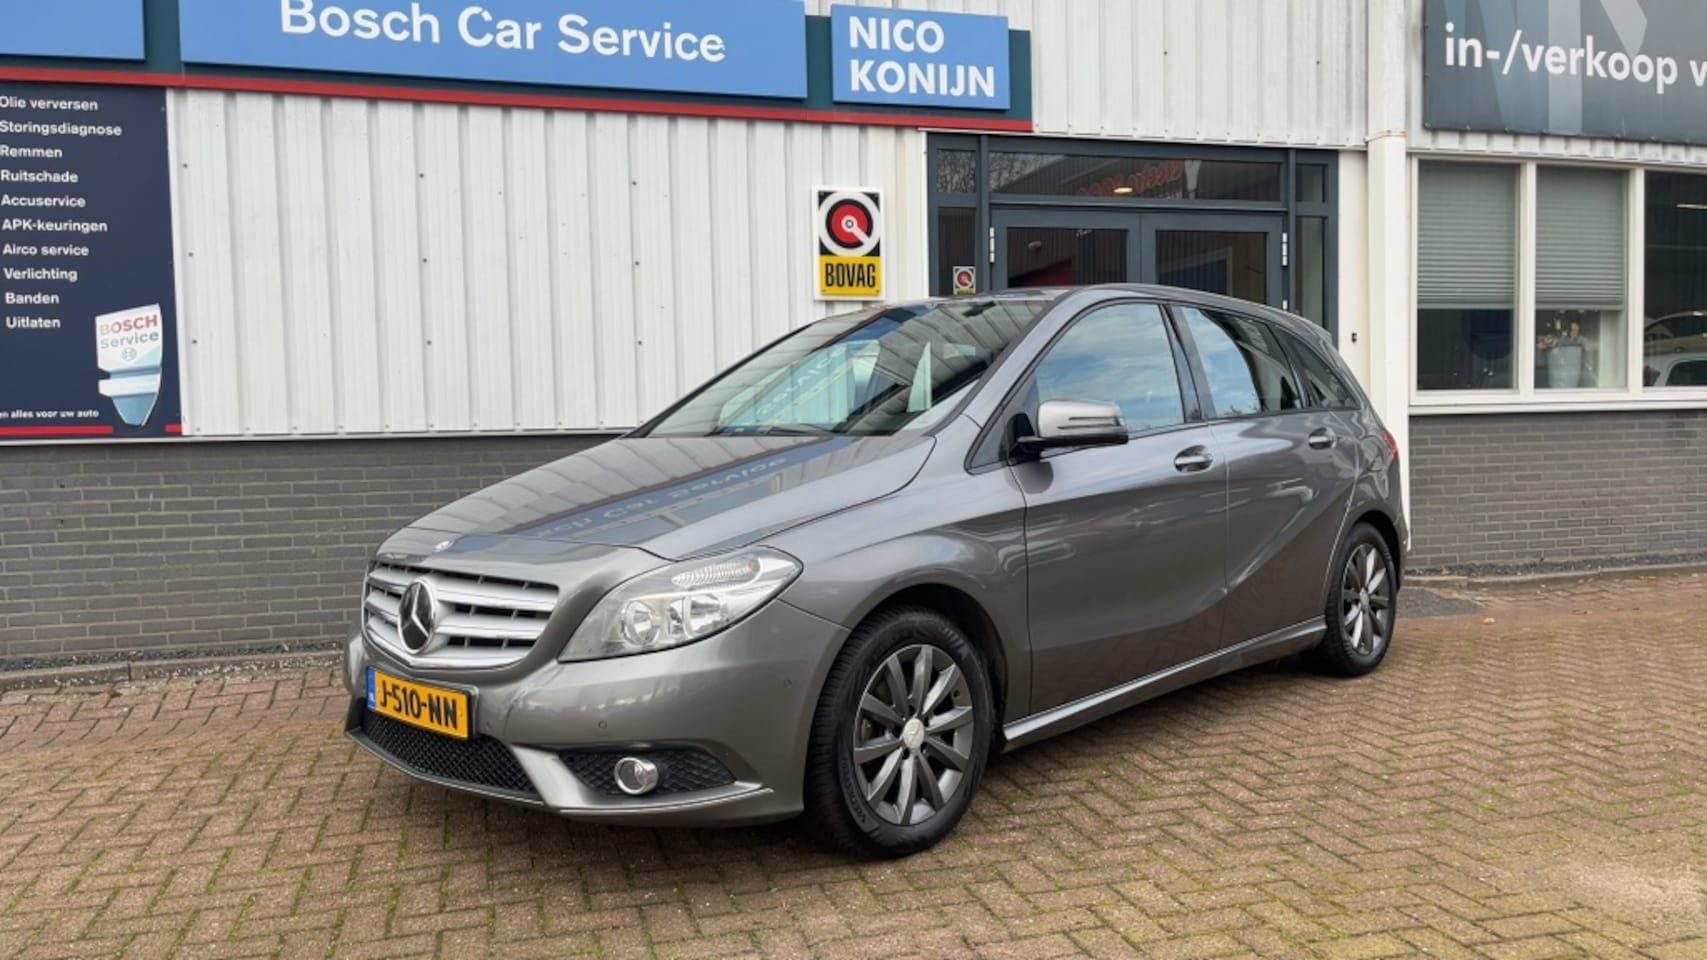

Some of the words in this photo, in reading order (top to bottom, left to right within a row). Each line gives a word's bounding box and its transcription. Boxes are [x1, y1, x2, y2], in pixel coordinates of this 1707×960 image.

[281, 0, 440, 43] Bosch
[458, 6, 542, 50] Car
[558, 14, 726, 63] Service
[850, 16, 945, 54] NICO
[1445, 22, 1678, 94] in-/verkoop
[850, 59, 995, 97] KONIJN
[0, 96, 26, 108] Olie
[30, 100, 98, 110] verversen
[0, 120, 122, 136] Storingsdiagnose
[0, 145, 63, 158] Remmen
[1, 170, 78, 183] Ruitschade
[1, 194, 86, 207] Accuservice
[2, 219, 108, 233] APK-keuringen
[3, 244, 38, 256] Airco
[41, 244, 89, 256] service
[4, 268, 78, 282] Verlichting
[825, 263, 876, 288] BOVAG
[5, 292, 60, 305] Banden
[6, 317, 61, 329] Uitlaten
[100, 314, 158, 335] BOSCH
[100, 331, 159, 349] Service
[11, 409, 34, 418] alles
[36, 410, 58, 418] voor
[60, 410, 75, 418] uw
[77, 409, 99, 418] auto
[380, 679, 457, 730] J-510-NN
